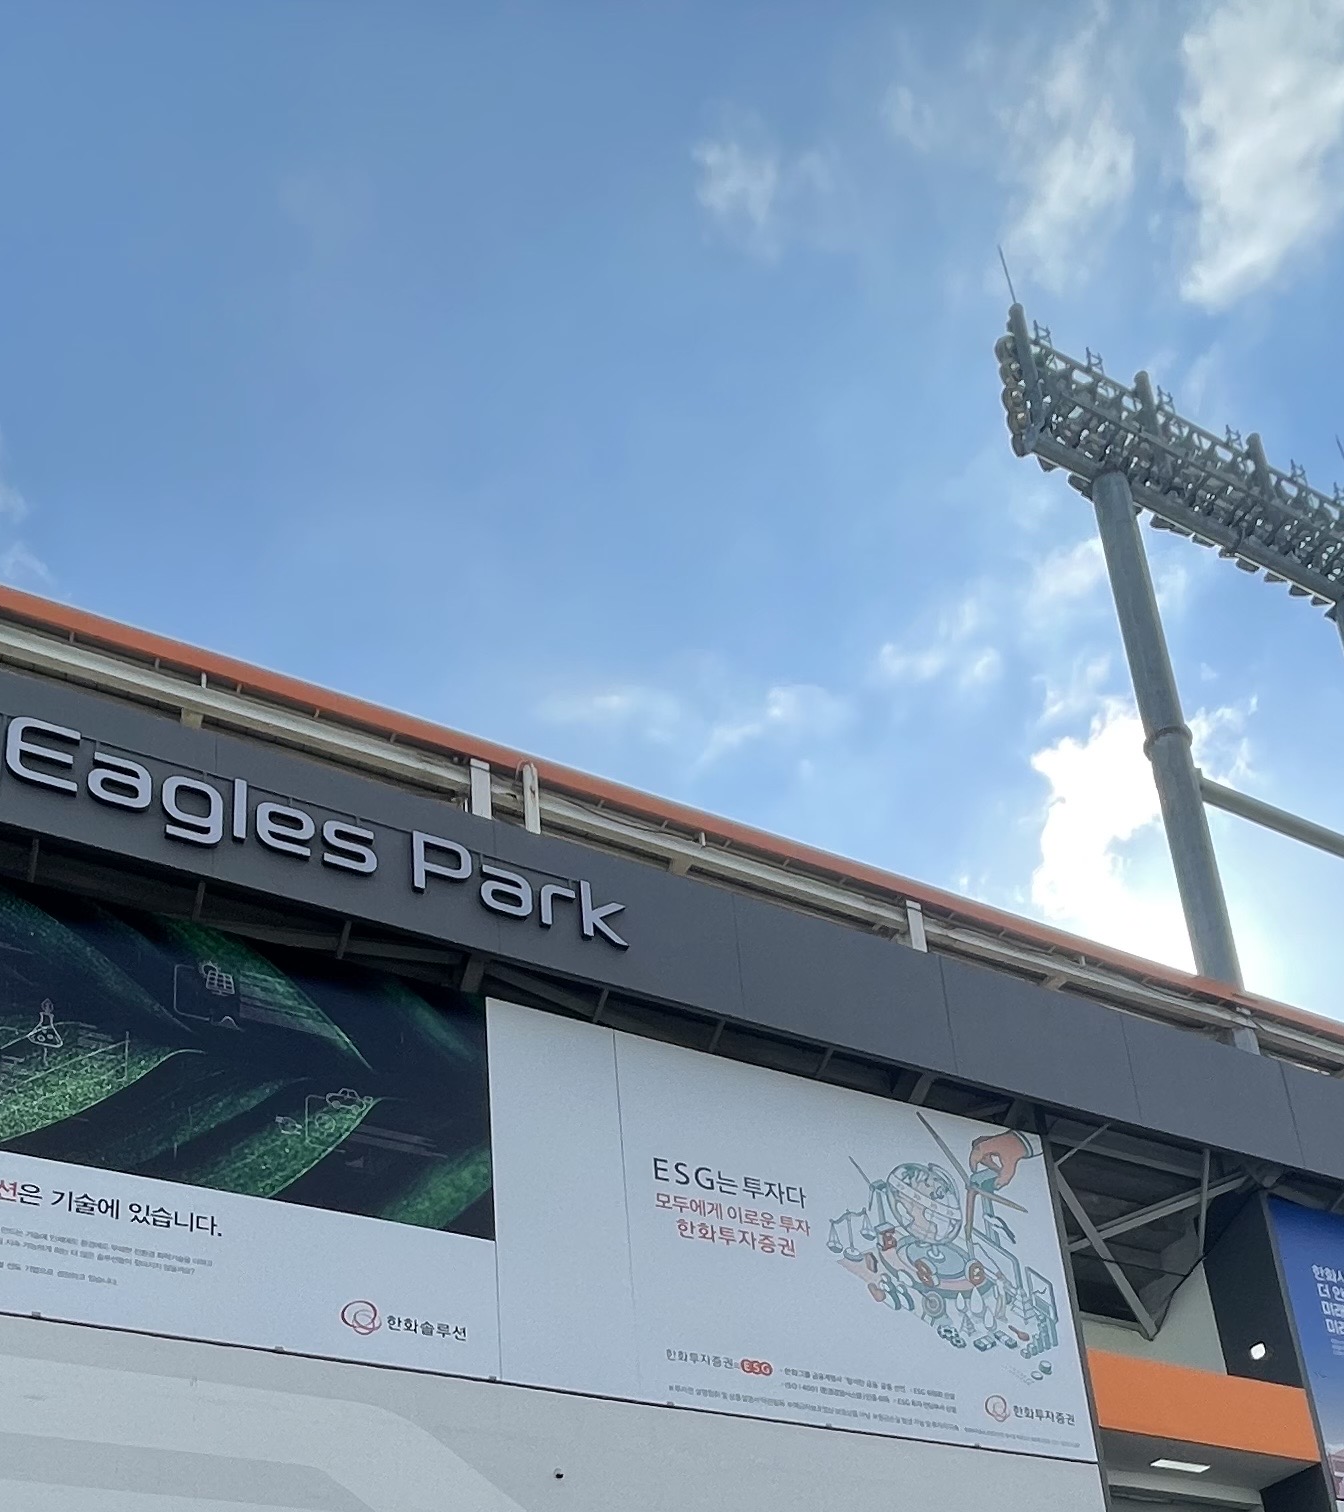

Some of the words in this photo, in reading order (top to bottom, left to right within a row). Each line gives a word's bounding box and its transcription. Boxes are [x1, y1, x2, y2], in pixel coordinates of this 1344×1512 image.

[5, 715, 380, 877] Eagles
[410, 829, 630, 950] Park
[653, 1157, 738, 1195] ESG는
[743, 1176, 807, 1209] 투자다
[51, 1190, 120, 1219] 기술에
[128, 1202, 222, 1236] 있습니다.
[656, 1192, 723, 1220] 모두에게
[727, 1206, 776, 1229] 이로운
[779, 1215, 810, 1236] 투자
[676, 1219, 796, 1258] 한화투자증권
[1317, 1283, 1331, 1298] 더
[387, 1313, 468, 1343] 한화솔루션
[742, 1360, 771, 1375] ESG
[1013, 1405, 1075, 1426] 한화투자증권
